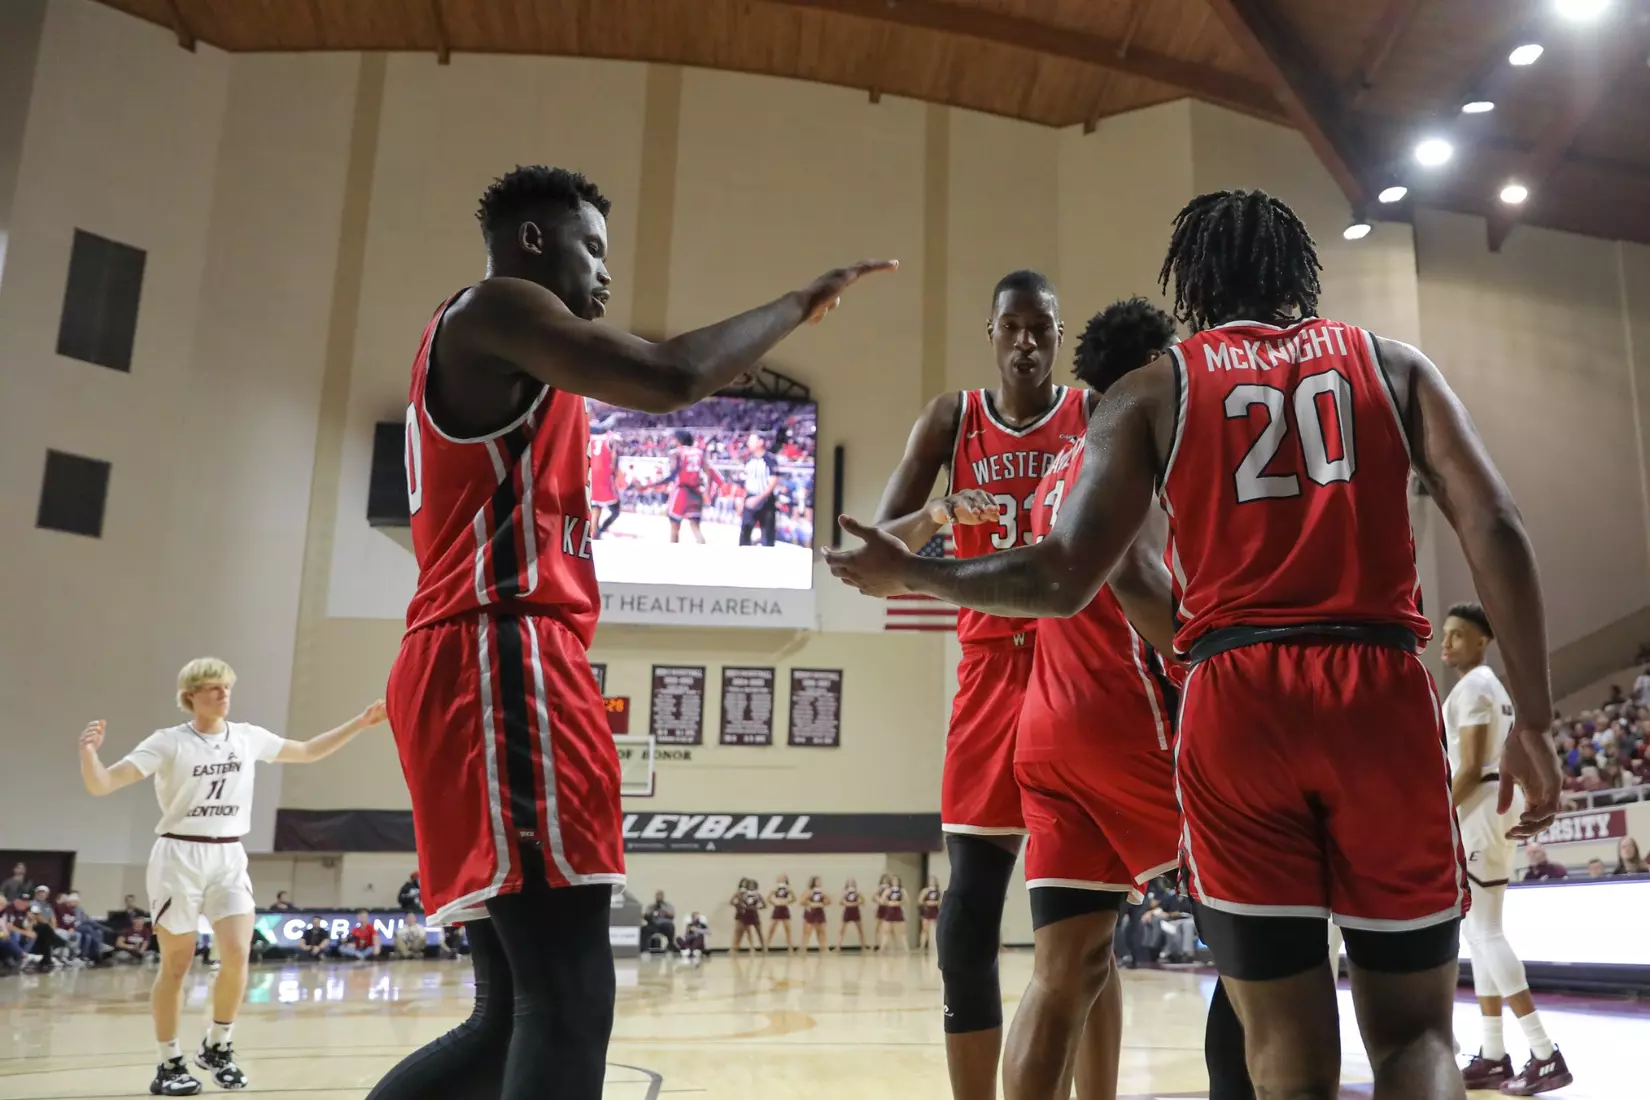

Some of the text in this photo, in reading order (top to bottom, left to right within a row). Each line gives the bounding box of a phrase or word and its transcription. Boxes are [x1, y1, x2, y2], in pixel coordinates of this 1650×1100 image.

[1223, 368, 1358, 504] 20
[619, 594, 704, 614] HEALTH
[711, 598, 783, 616] ARENA
[192, 761, 242, 777] EASTERN
[206, 778, 227, 800] 11
[622, 814, 814, 840] LEYBALL
